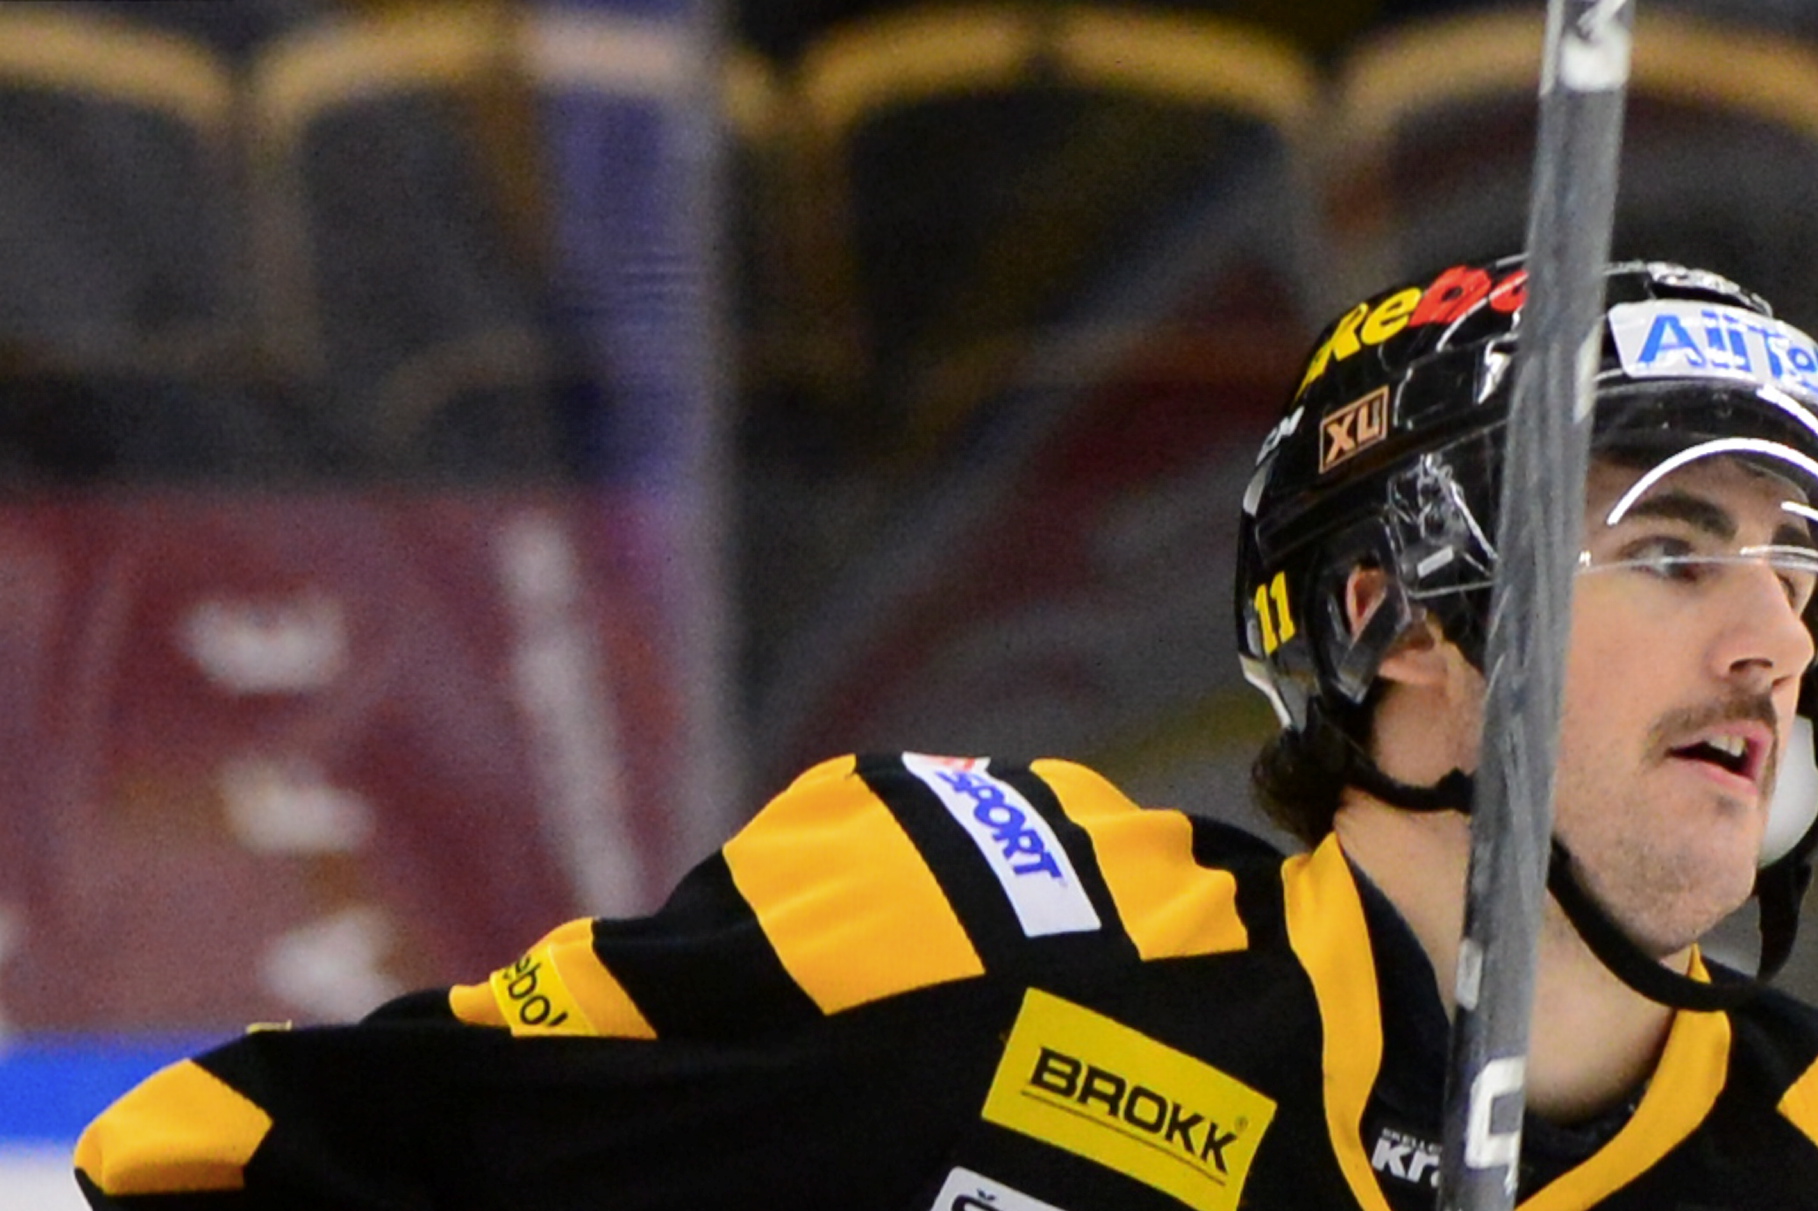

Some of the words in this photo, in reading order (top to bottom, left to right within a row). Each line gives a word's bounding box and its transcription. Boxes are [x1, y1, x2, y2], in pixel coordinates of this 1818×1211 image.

[1253, 570, 1296, 657] 11
[935, 770, 1063, 878] SPORT
[1029, 1046, 1237, 1176] BROKK
[1371, 1137, 1441, 1188] kr
